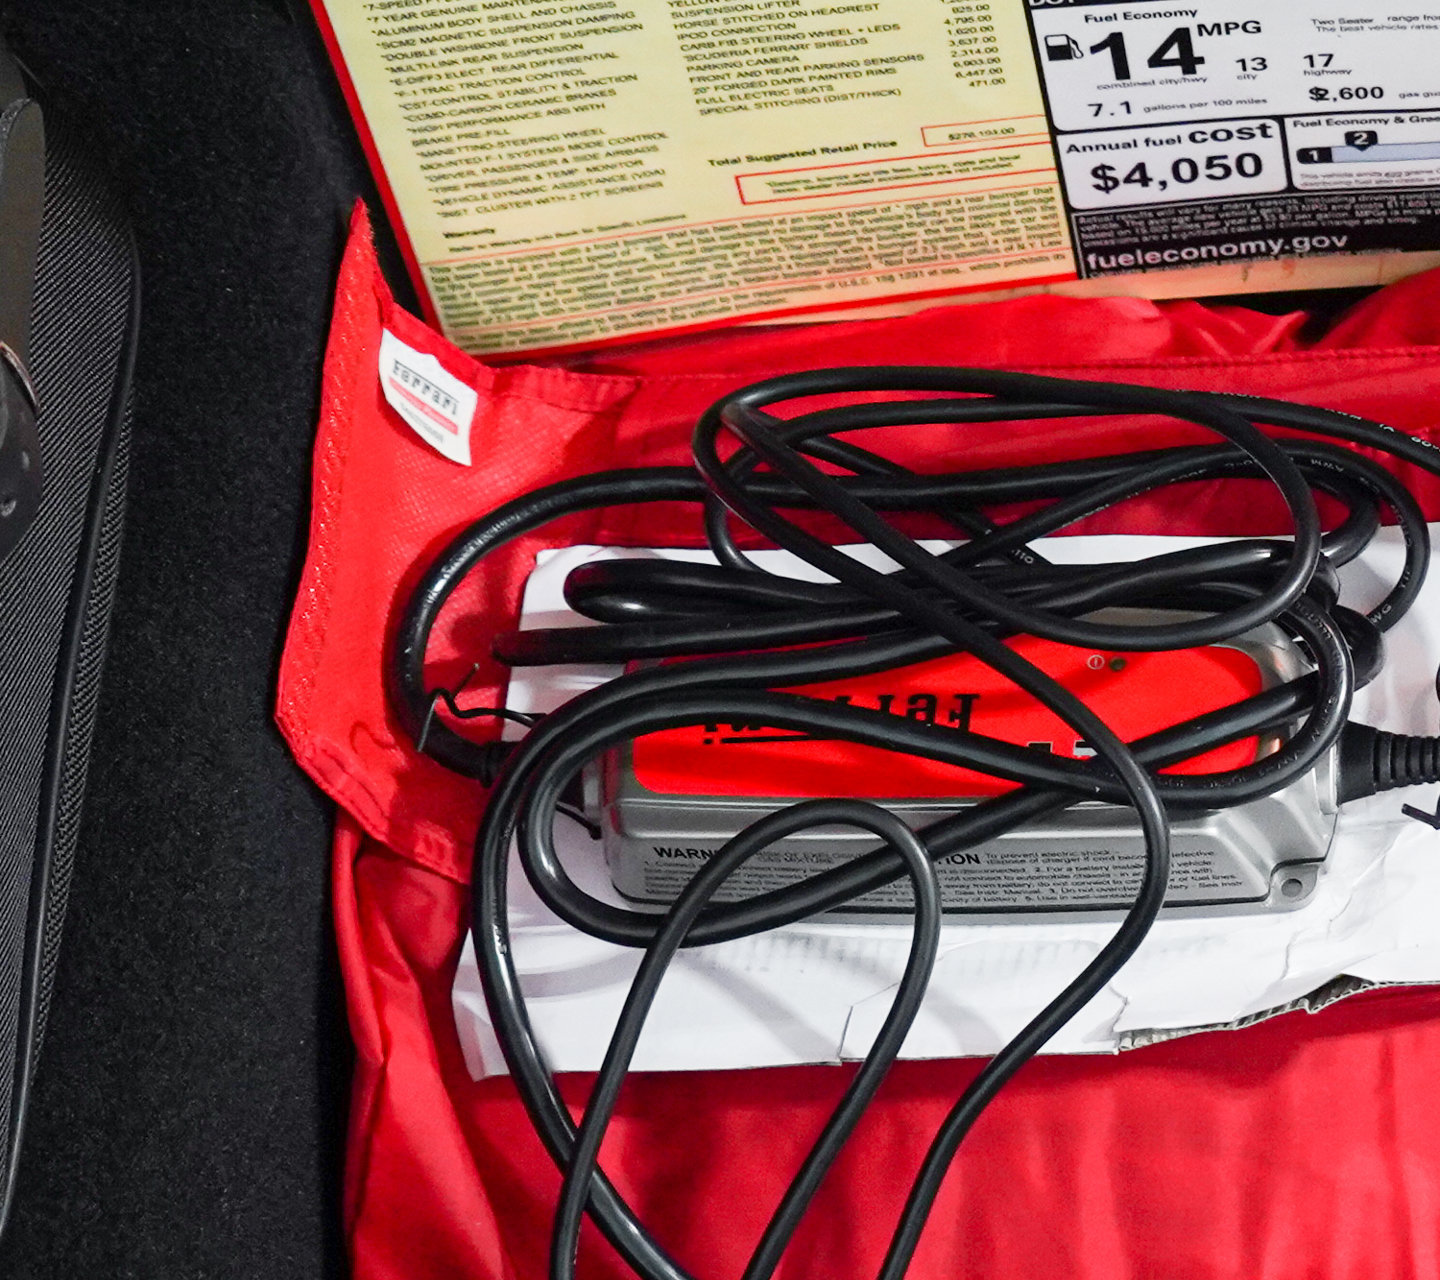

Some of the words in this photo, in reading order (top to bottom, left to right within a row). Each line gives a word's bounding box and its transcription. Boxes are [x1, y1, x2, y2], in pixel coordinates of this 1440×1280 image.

[1083, 13, 1118, 24] Fuel
[1122, 10, 1198, 21] Economy
[1089, 26, 1205, 81] 14
[1196, 20, 1262, 37] MPG
[1235, 57, 1268, 72] 13
[1303, 53, 1334, 68] 17
[1087, 100, 1132, 117] 7.1
[1066, 138, 1138, 154] Annual
[1144, 135, 1182, 147] fuel
[1188, 123, 1274, 146] cost
[1091, 152, 1263, 196] $4,050
[1086, 234, 1348, 271] fueleconomy.gov
[392, 359, 459, 416] Ferrari
